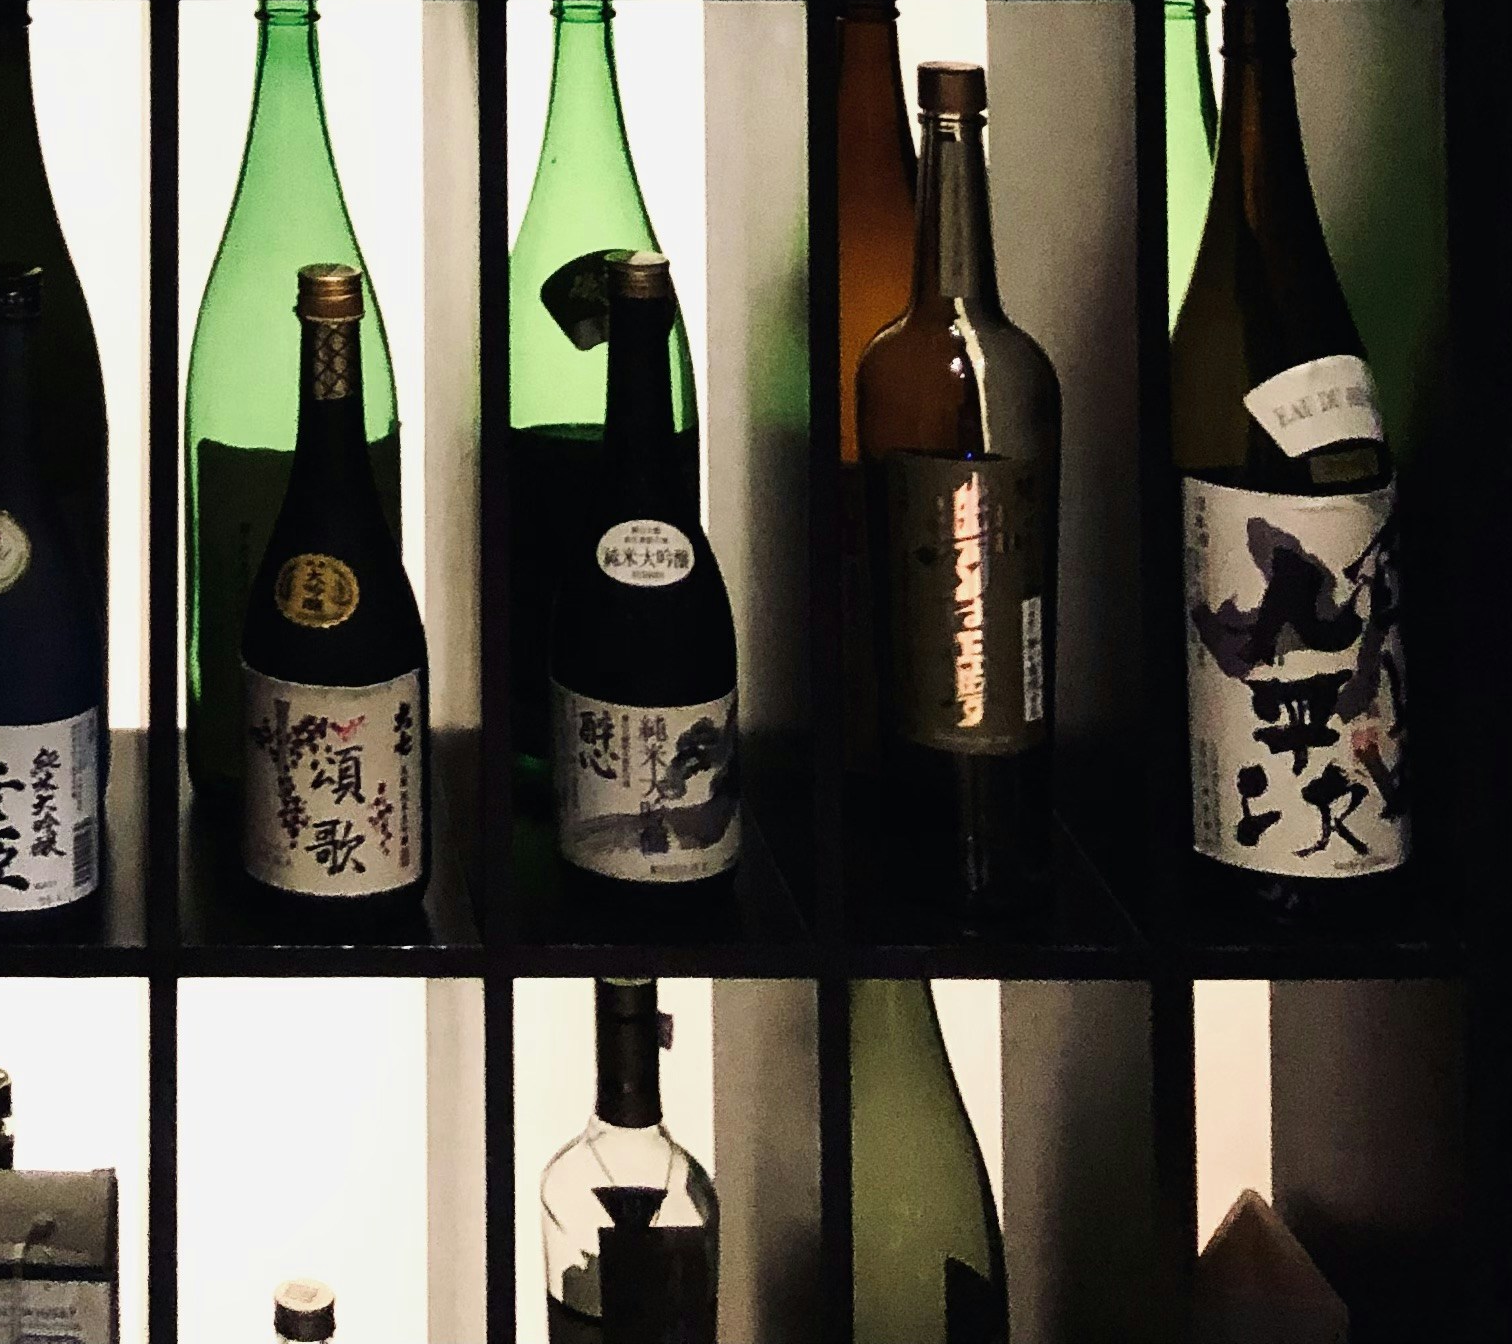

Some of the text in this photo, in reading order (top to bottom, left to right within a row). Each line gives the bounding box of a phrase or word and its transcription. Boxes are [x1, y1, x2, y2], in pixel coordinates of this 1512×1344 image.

[603, 547, 689, 569] 純米大吟醸
